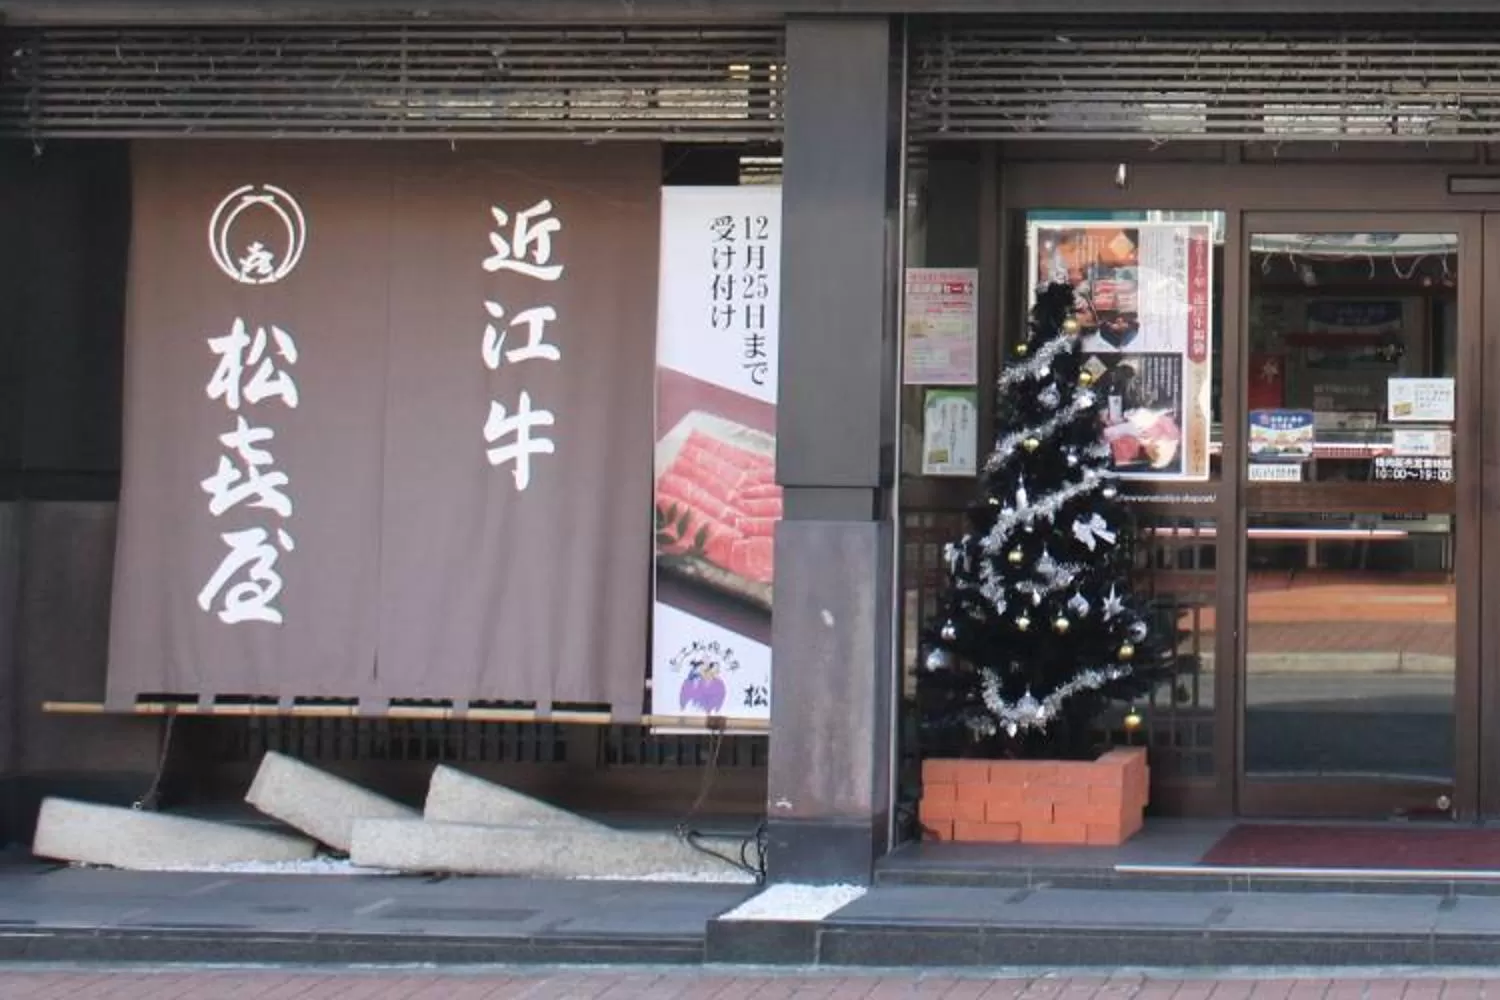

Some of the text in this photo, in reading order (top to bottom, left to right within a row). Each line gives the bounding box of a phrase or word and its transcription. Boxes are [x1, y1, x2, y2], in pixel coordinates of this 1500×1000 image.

[482, 198, 566, 492] 近江牛
[710, 214, 737, 330] 受け付け
[742, 214, 769, 386] 12月25日まで
